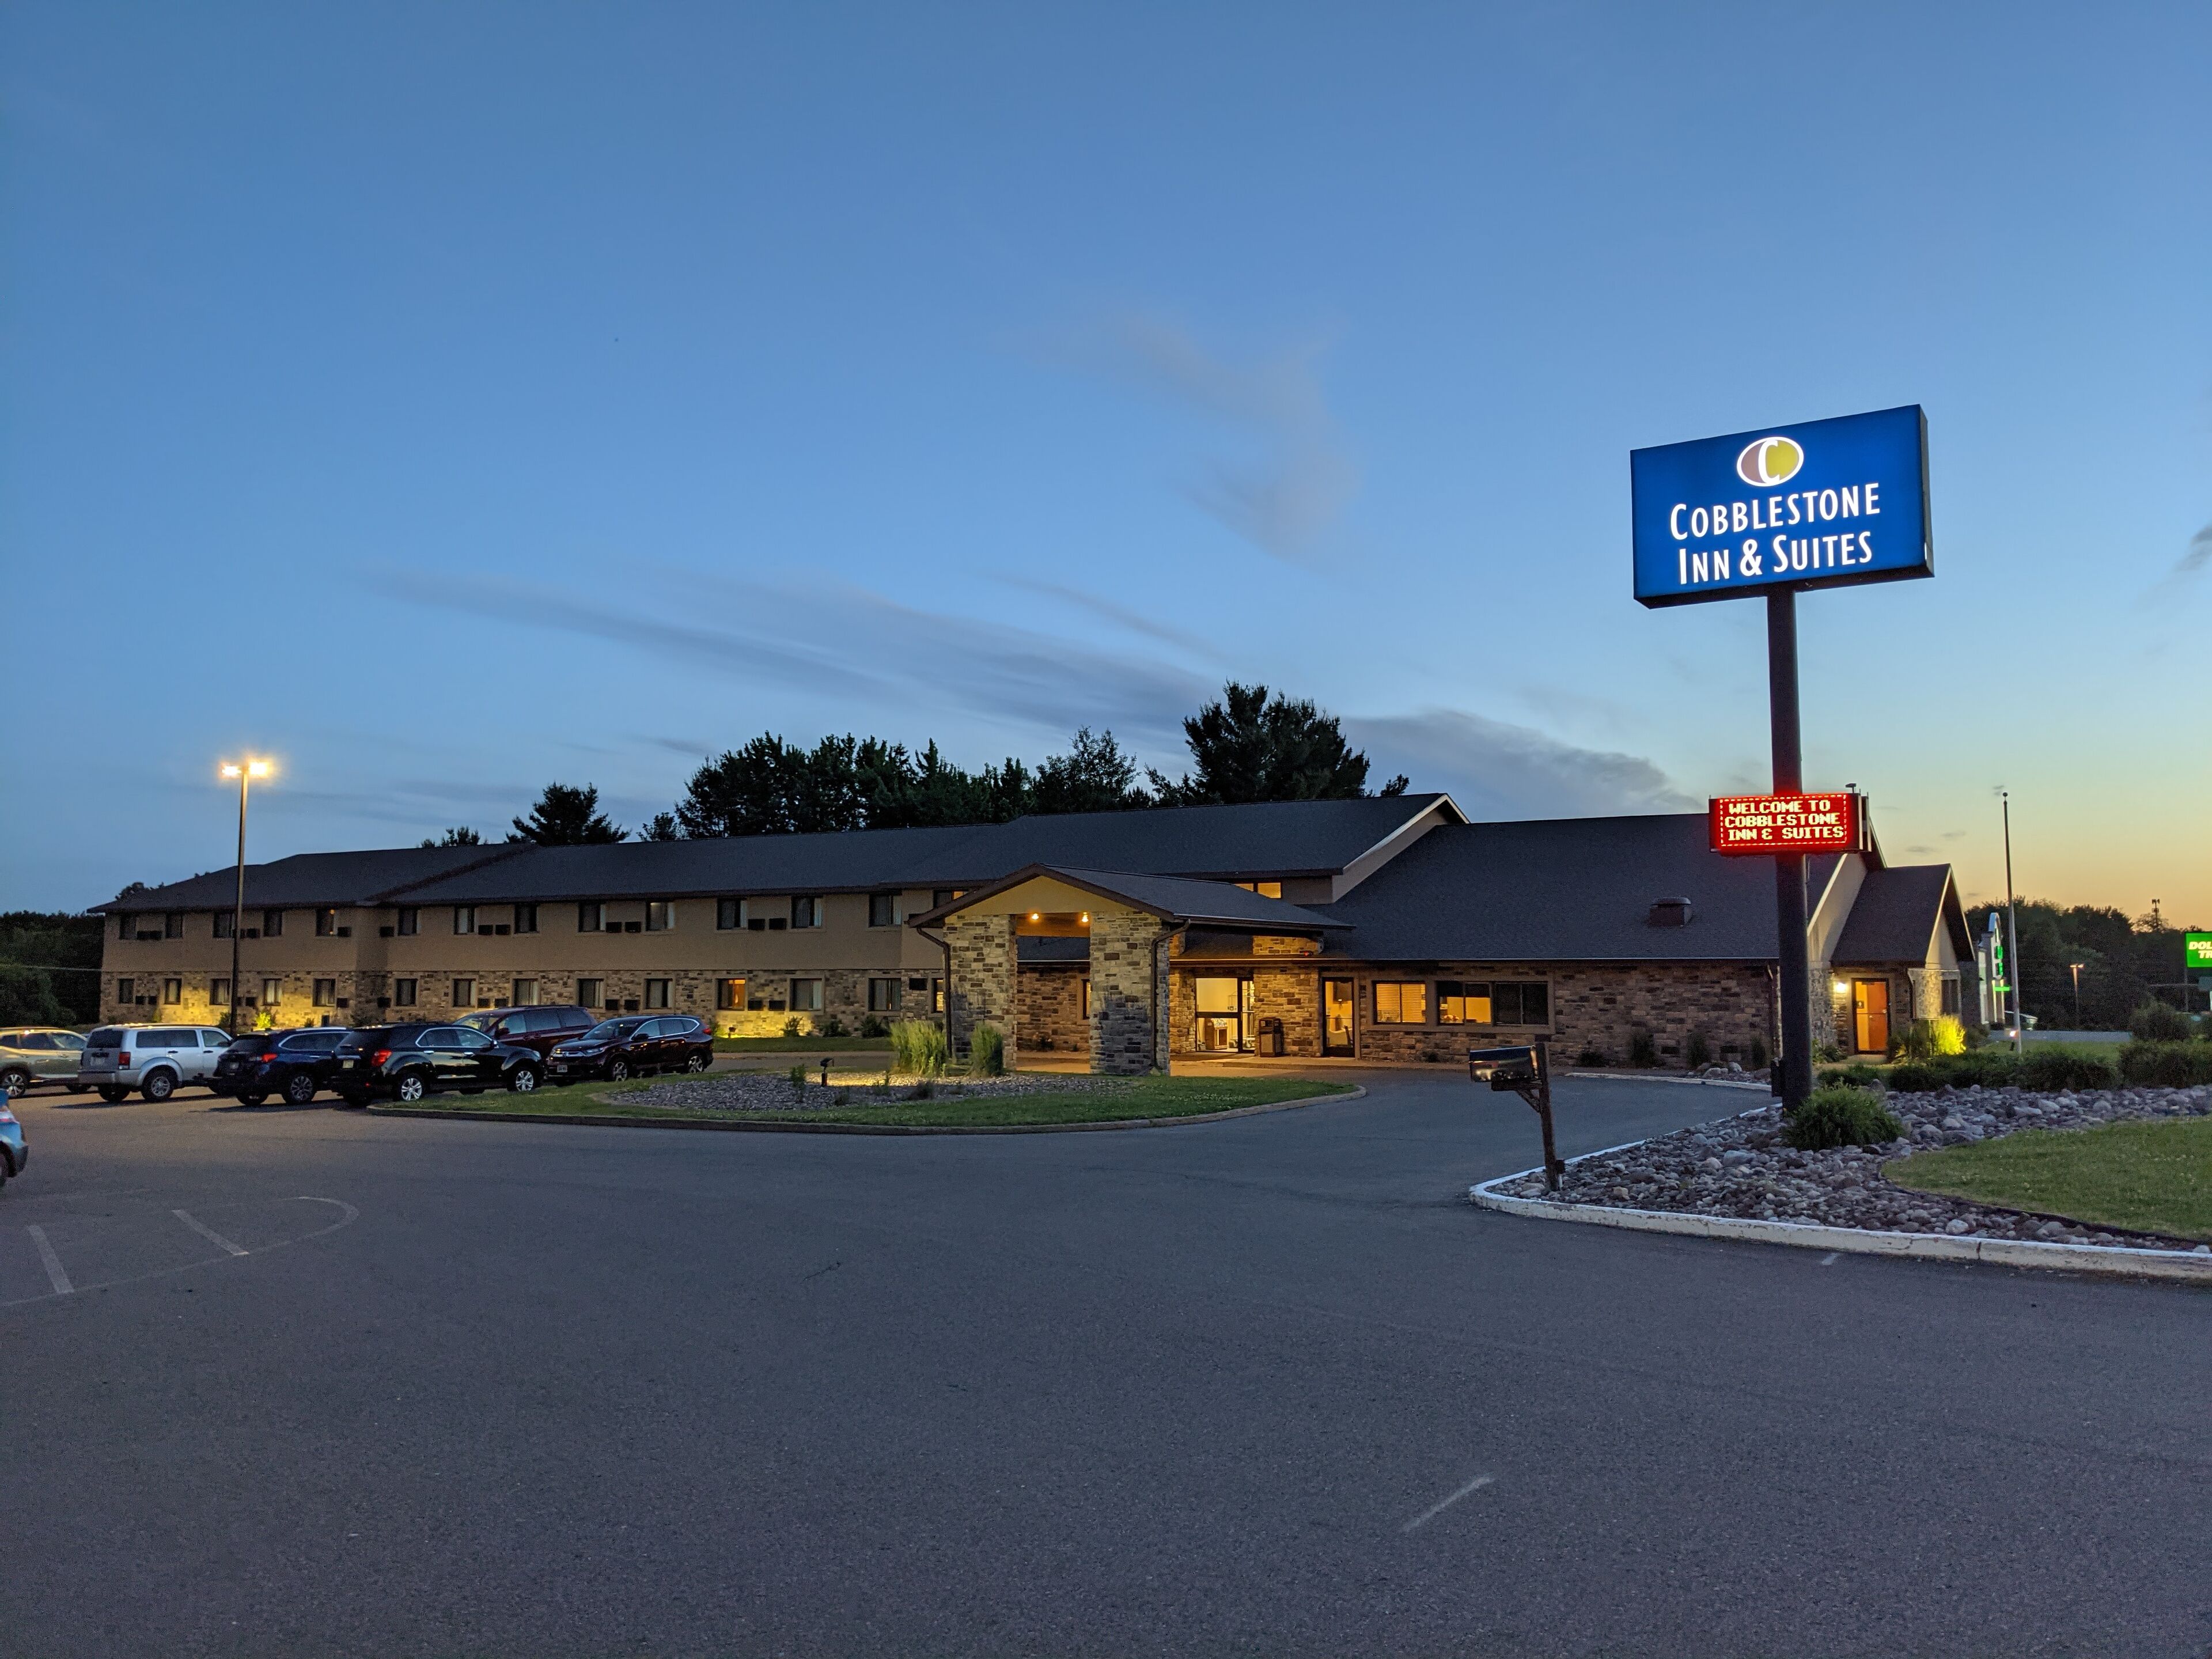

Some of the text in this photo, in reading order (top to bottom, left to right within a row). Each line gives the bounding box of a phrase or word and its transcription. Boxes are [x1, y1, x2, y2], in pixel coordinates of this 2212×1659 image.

[1671, 483, 1880, 540] COBBLESTONE
[1679, 531, 1872, 585] INN & SUITES
[1728, 800, 1831, 815] WELCOME TO
[1724, 812, 1840, 828] COBBLESTONE
[1728, 825, 1844, 841] INN & SUITES
